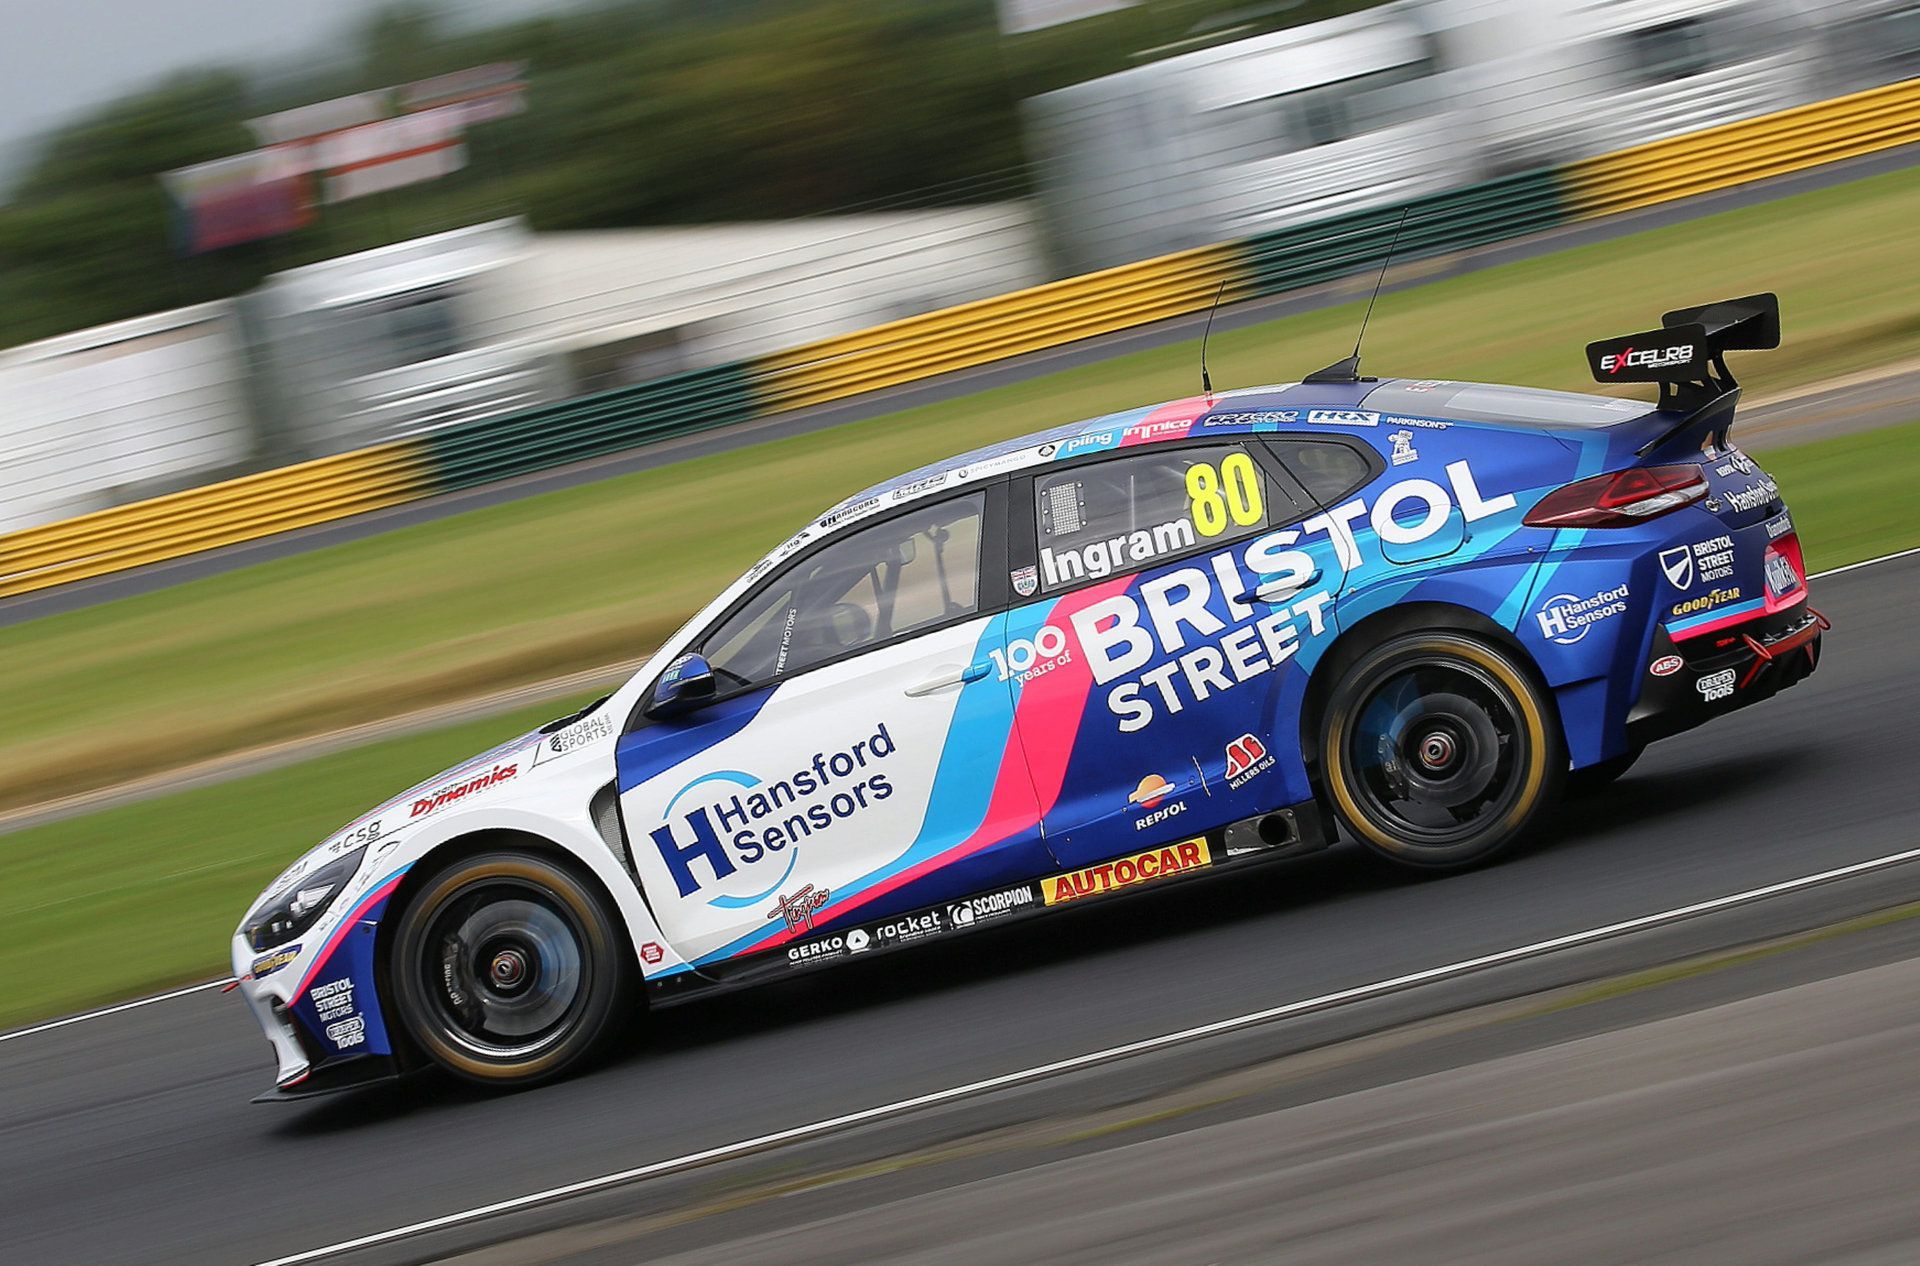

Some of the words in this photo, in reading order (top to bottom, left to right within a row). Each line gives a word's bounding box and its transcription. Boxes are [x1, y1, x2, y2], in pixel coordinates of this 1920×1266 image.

[1600, 344, 1694, 374] EXCELR8
[1068, 432, 1113, 452] piling
[1184, 452, 1265, 537] 80
[1041, 516, 1196, 587] Ingram
[1692, 534, 1735, 556] BRISTOL
[1069, 459, 1517, 685] BRISTOL
[1697, 550, 1735, 572] STREET
[1700, 565, 1734, 583] MOTORS
[1560, 583, 1630, 617] Hansford
[1566, 601, 1627, 629] Sensors
[1672, 587, 1741, 616] GOODYEAR
[774, 641, 789, 677] TREET
[783, 608, 797, 645] MOTORS
[989, 625, 1066, 682] 100
[1015, 660, 1056, 687] years
[1057, 649, 1072, 666] of
[1107, 590, 1338, 733] STREET
[1655, 658, 1679, 672] ABS
[560, 717, 604, 740] GLOBAL
[562, 725, 608, 751] SPORTS
[714, 722, 897, 832] Hansford
[1229, 767, 1260, 790] MILLERS
[1258, 755, 1276, 772] OILS
[409, 763, 518, 818] Dynamics
[732, 773, 894, 865] Sensors
[1135, 801, 1188, 832] REPSOL
[1054, 842, 1201, 901] AUTOCAR
[973, 885, 1033, 916] SCORPION
[876, 910, 941, 941] rocket
[788, 936, 843, 960] GERKO
[310, 977, 355, 1002] BRISTOL
[315, 989, 353, 1013] STREET
[319, 1003, 354, 1023] MOTORS
